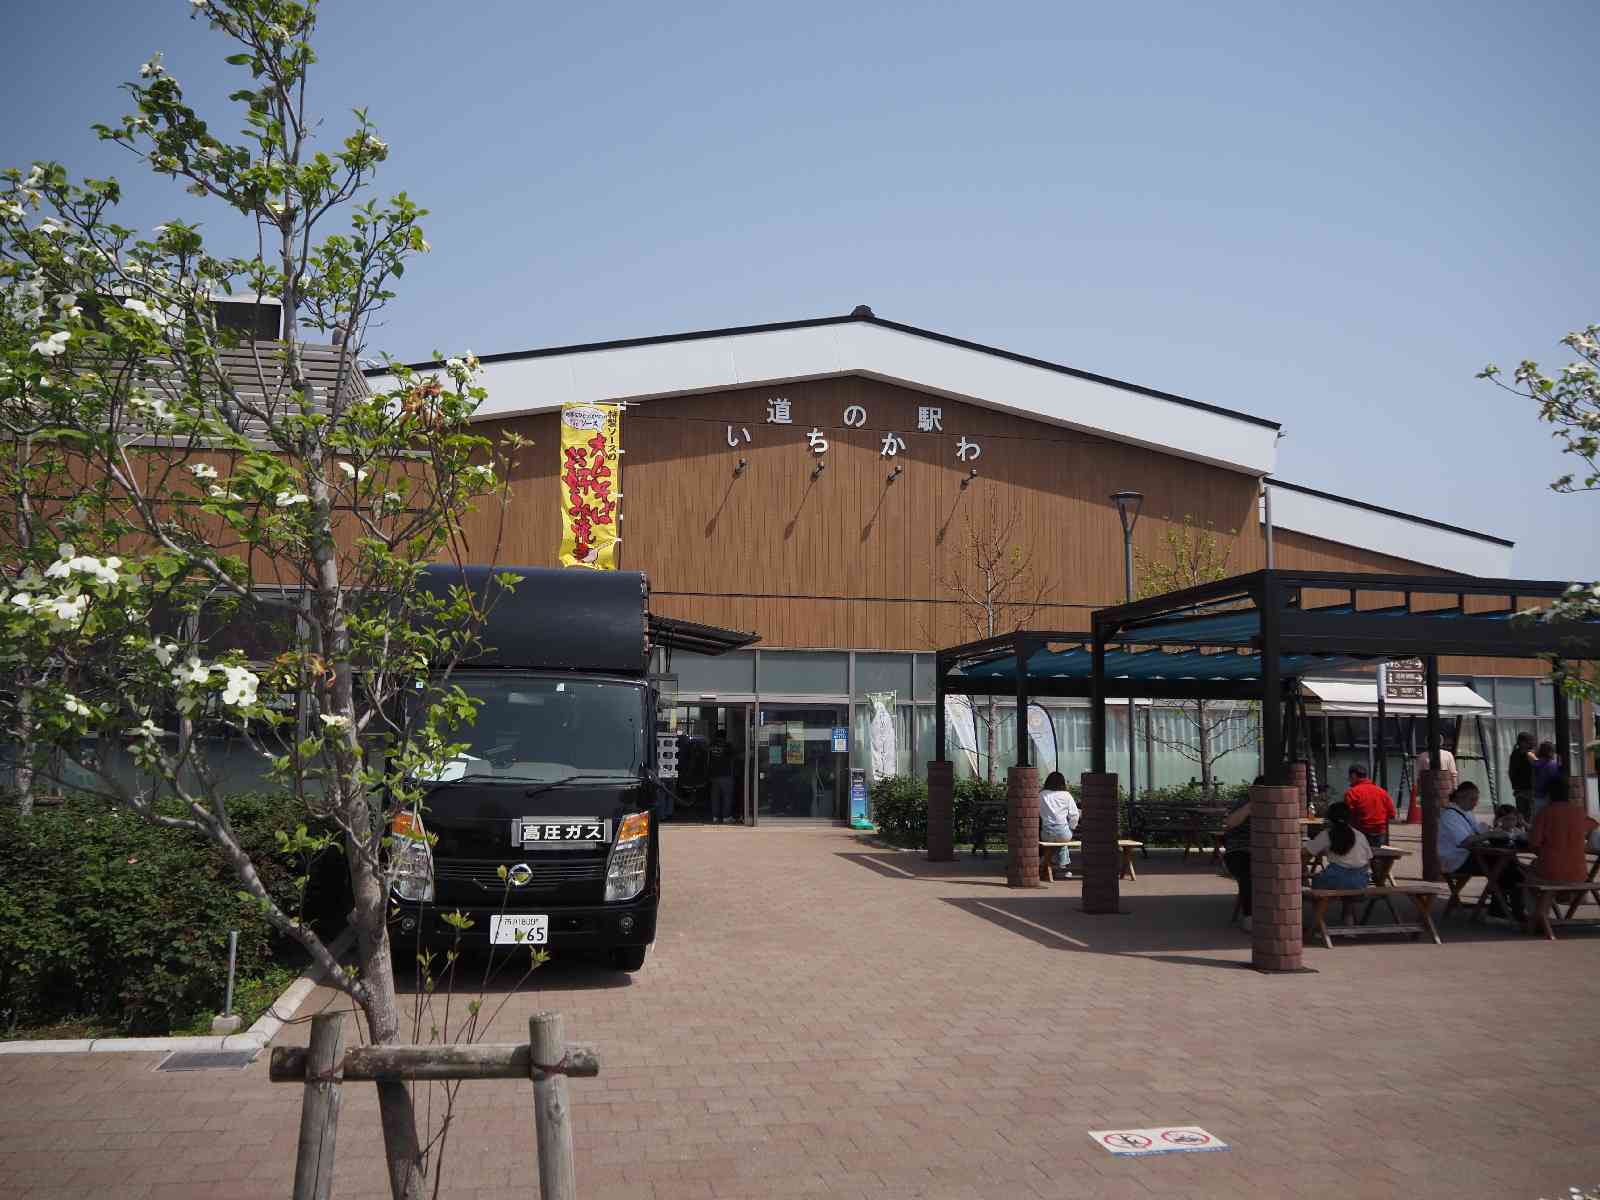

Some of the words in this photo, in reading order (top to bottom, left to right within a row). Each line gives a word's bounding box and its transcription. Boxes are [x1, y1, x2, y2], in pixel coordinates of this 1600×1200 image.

[766, 398, 943, 432] 道の駅
[727, 425, 982, 462] いちかわ
[523, 824, 602, 840] 高圧ガス
